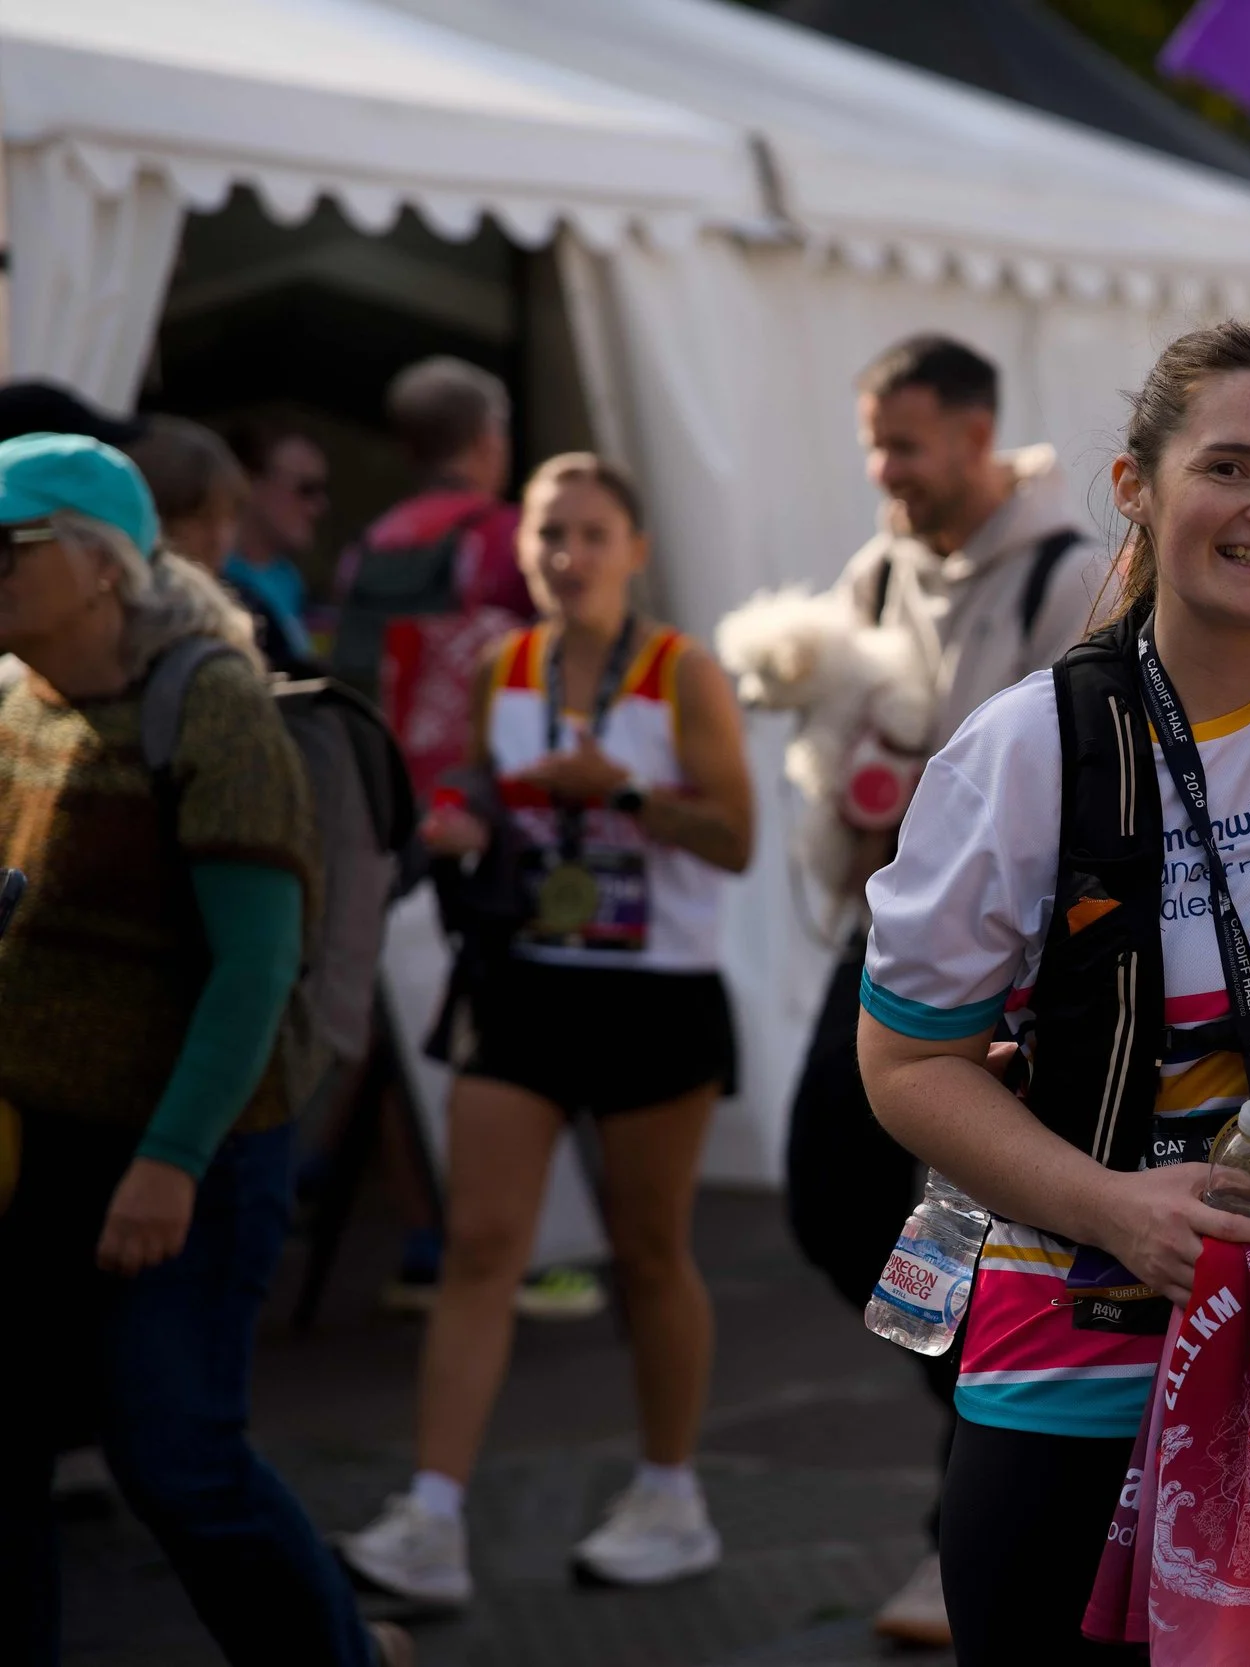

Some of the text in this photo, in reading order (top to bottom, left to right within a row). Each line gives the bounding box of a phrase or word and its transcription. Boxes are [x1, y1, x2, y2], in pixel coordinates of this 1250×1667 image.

[1147, 658, 1188, 743] CARDIFF HALF
[1182, 772, 1206, 808] 2026
[881, 1267, 931, 1300] CARREG
[888, 1254, 938, 1288] BRECON
[892, 1288, 906, 1299] STILL
[1109, 1287, 1147, 1298] PURPLE
[1093, 1302, 1124, 1319] R4W
[1189, 1286, 1242, 1340] KM
